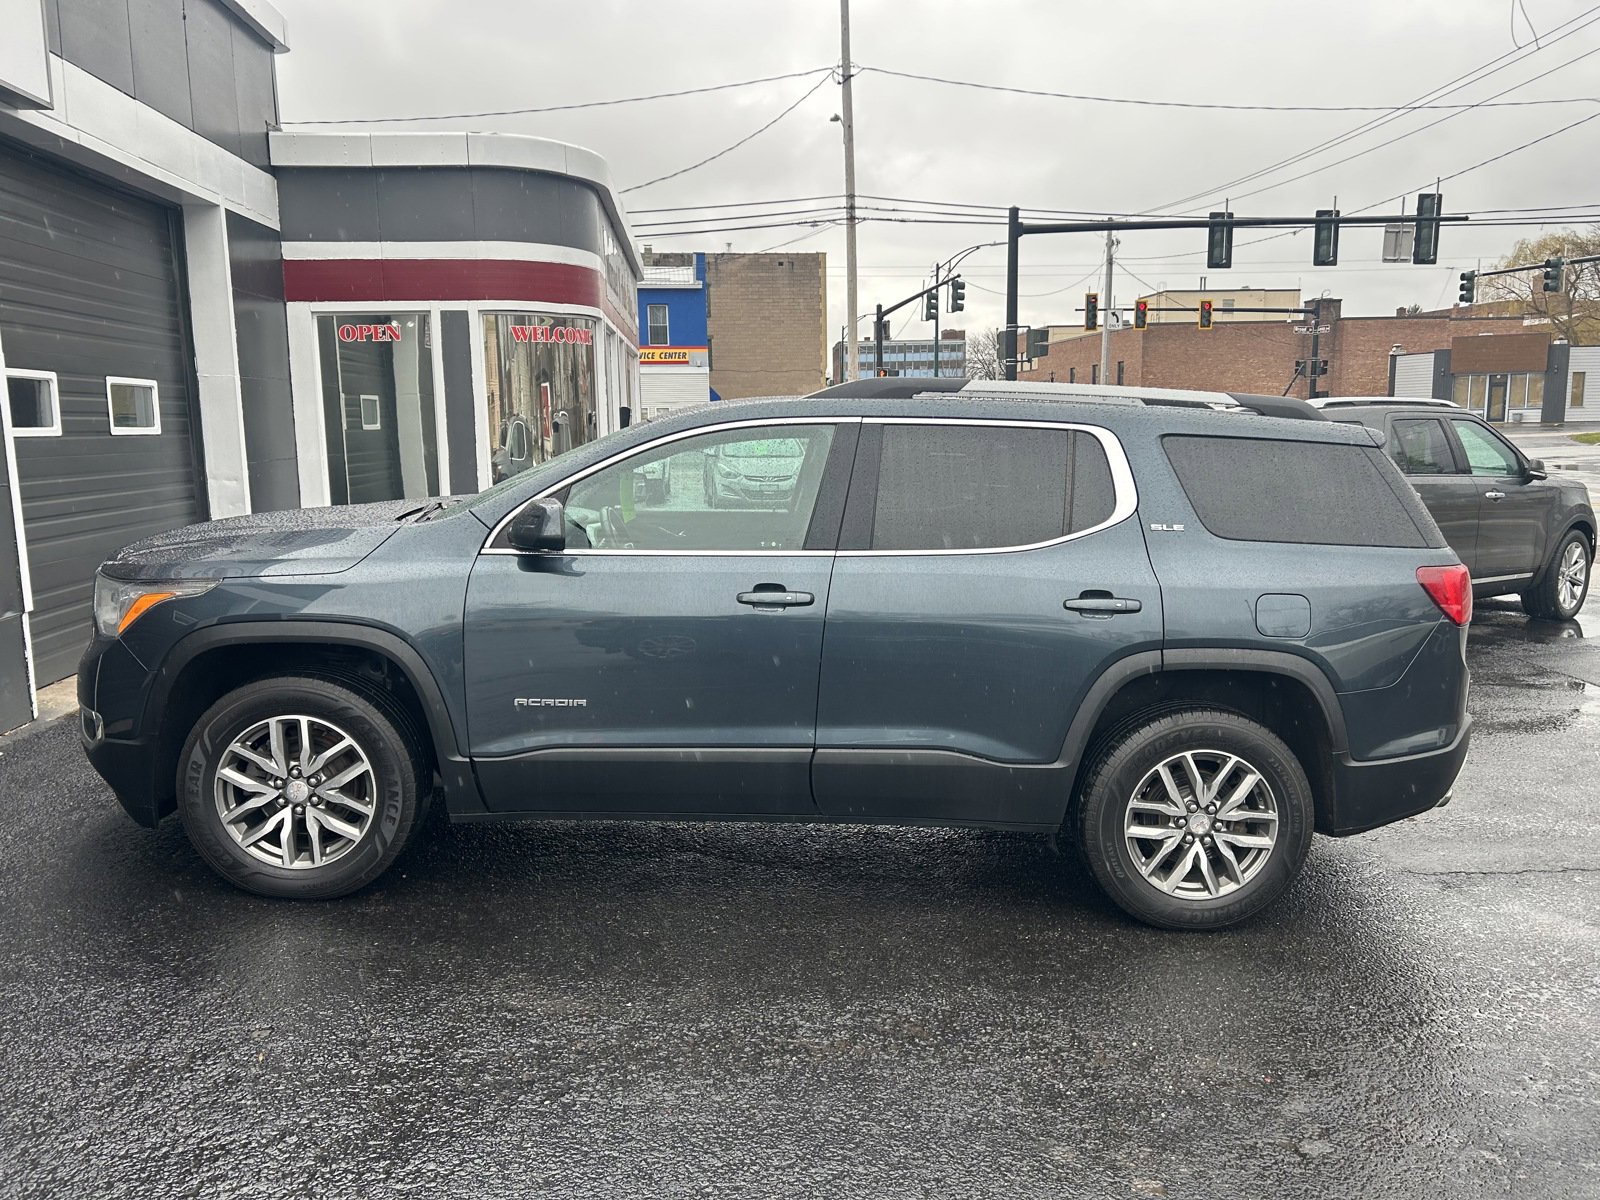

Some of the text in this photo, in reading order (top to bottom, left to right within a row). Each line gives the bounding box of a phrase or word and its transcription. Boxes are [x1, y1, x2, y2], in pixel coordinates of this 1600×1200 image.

[338, 324, 402, 342] OPEN
[659, 351, 688, 360] CENTER
[1150, 523, 1185, 532] SLE
[513, 698, 587, 707] ACADIA
